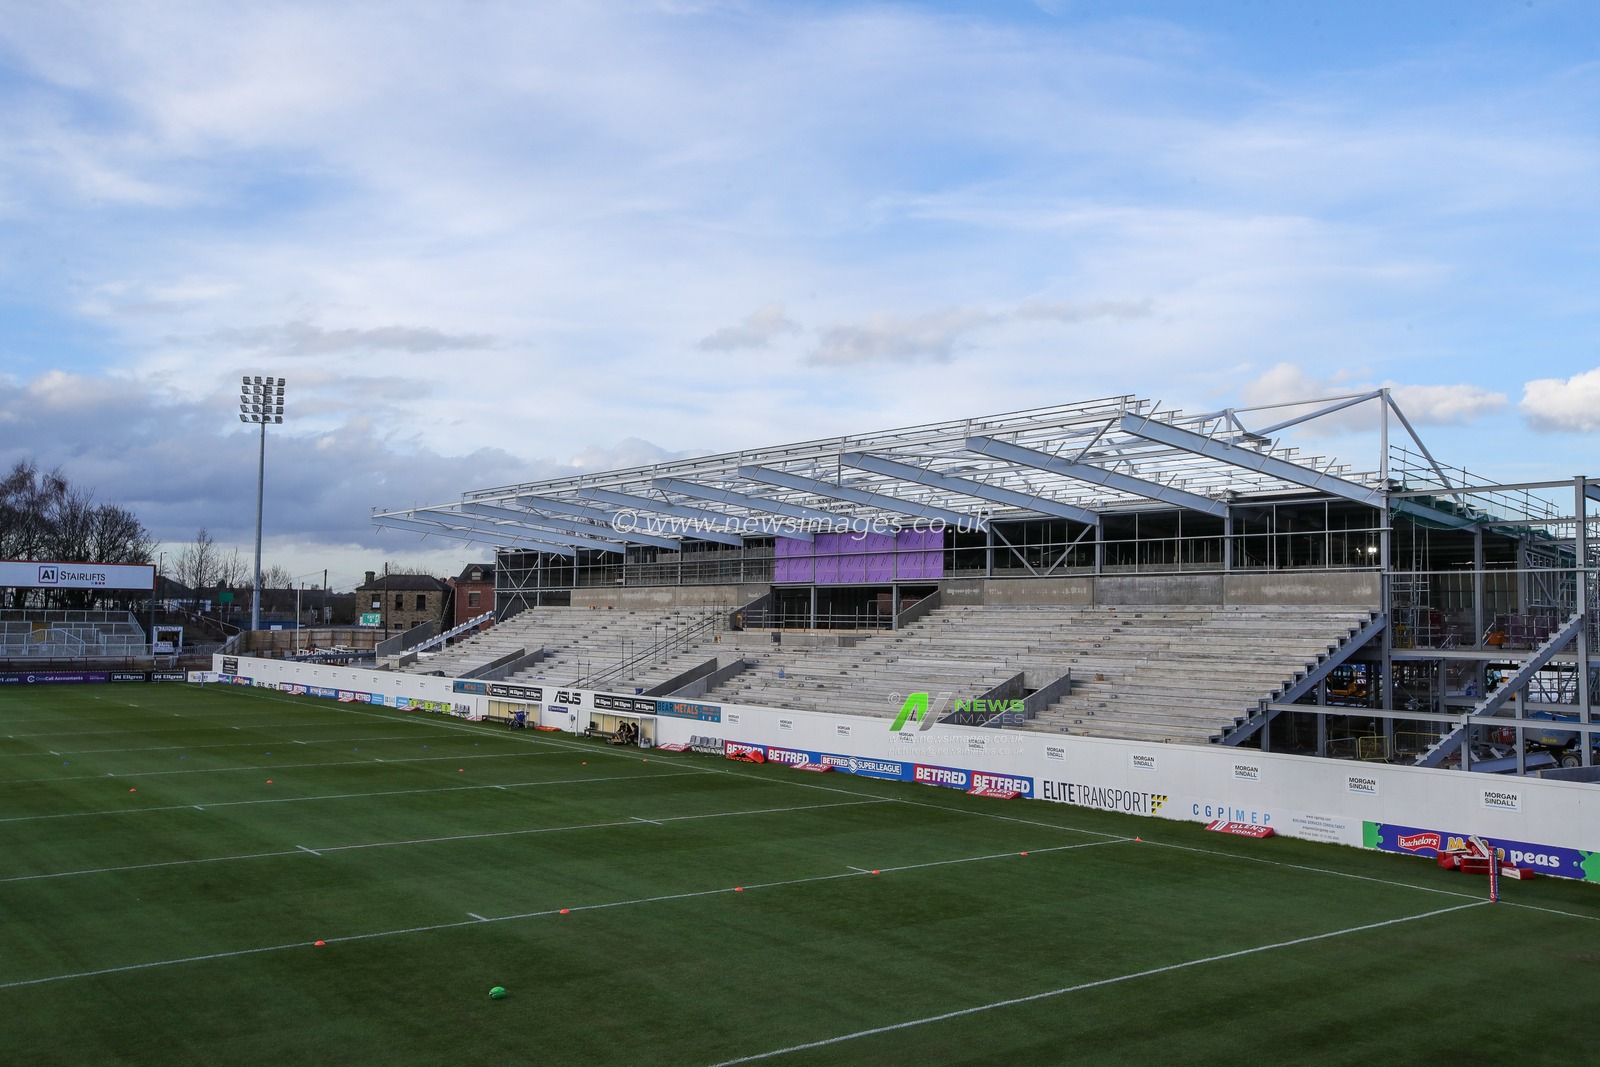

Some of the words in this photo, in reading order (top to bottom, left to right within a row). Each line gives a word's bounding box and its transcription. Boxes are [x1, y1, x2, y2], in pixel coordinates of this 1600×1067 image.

[42, 570, 54, 579] A1
[60, 571, 106, 581] STAIRLIFTS
[554, 691, 581, 705] ASUS
[657, 700, 673, 712] BEAR
[674, 704, 698, 714] METALS
[768, 749, 809, 763] BETFRED
[823, 757, 848, 766] BETFRED
[858, 762, 875, 770] SUPER
[876, 763, 900, 773] LEAGUE
[916, 767, 966, 785] BETFRED
[1349, 777, 1376, 785] MORGAN
[973, 774, 1030, 793] BETFRED
[1349, 783, 1374, 791] SINDALL
[1484, 791, 1517, 800] MORGAN
[1485, 798, 1515, 807] SINDALL
[1230, 824, 1266, 833] GLEN'S
[1400, 836, 1437, 846] Batchelors
[1510, 850, 1560, 868] peas
